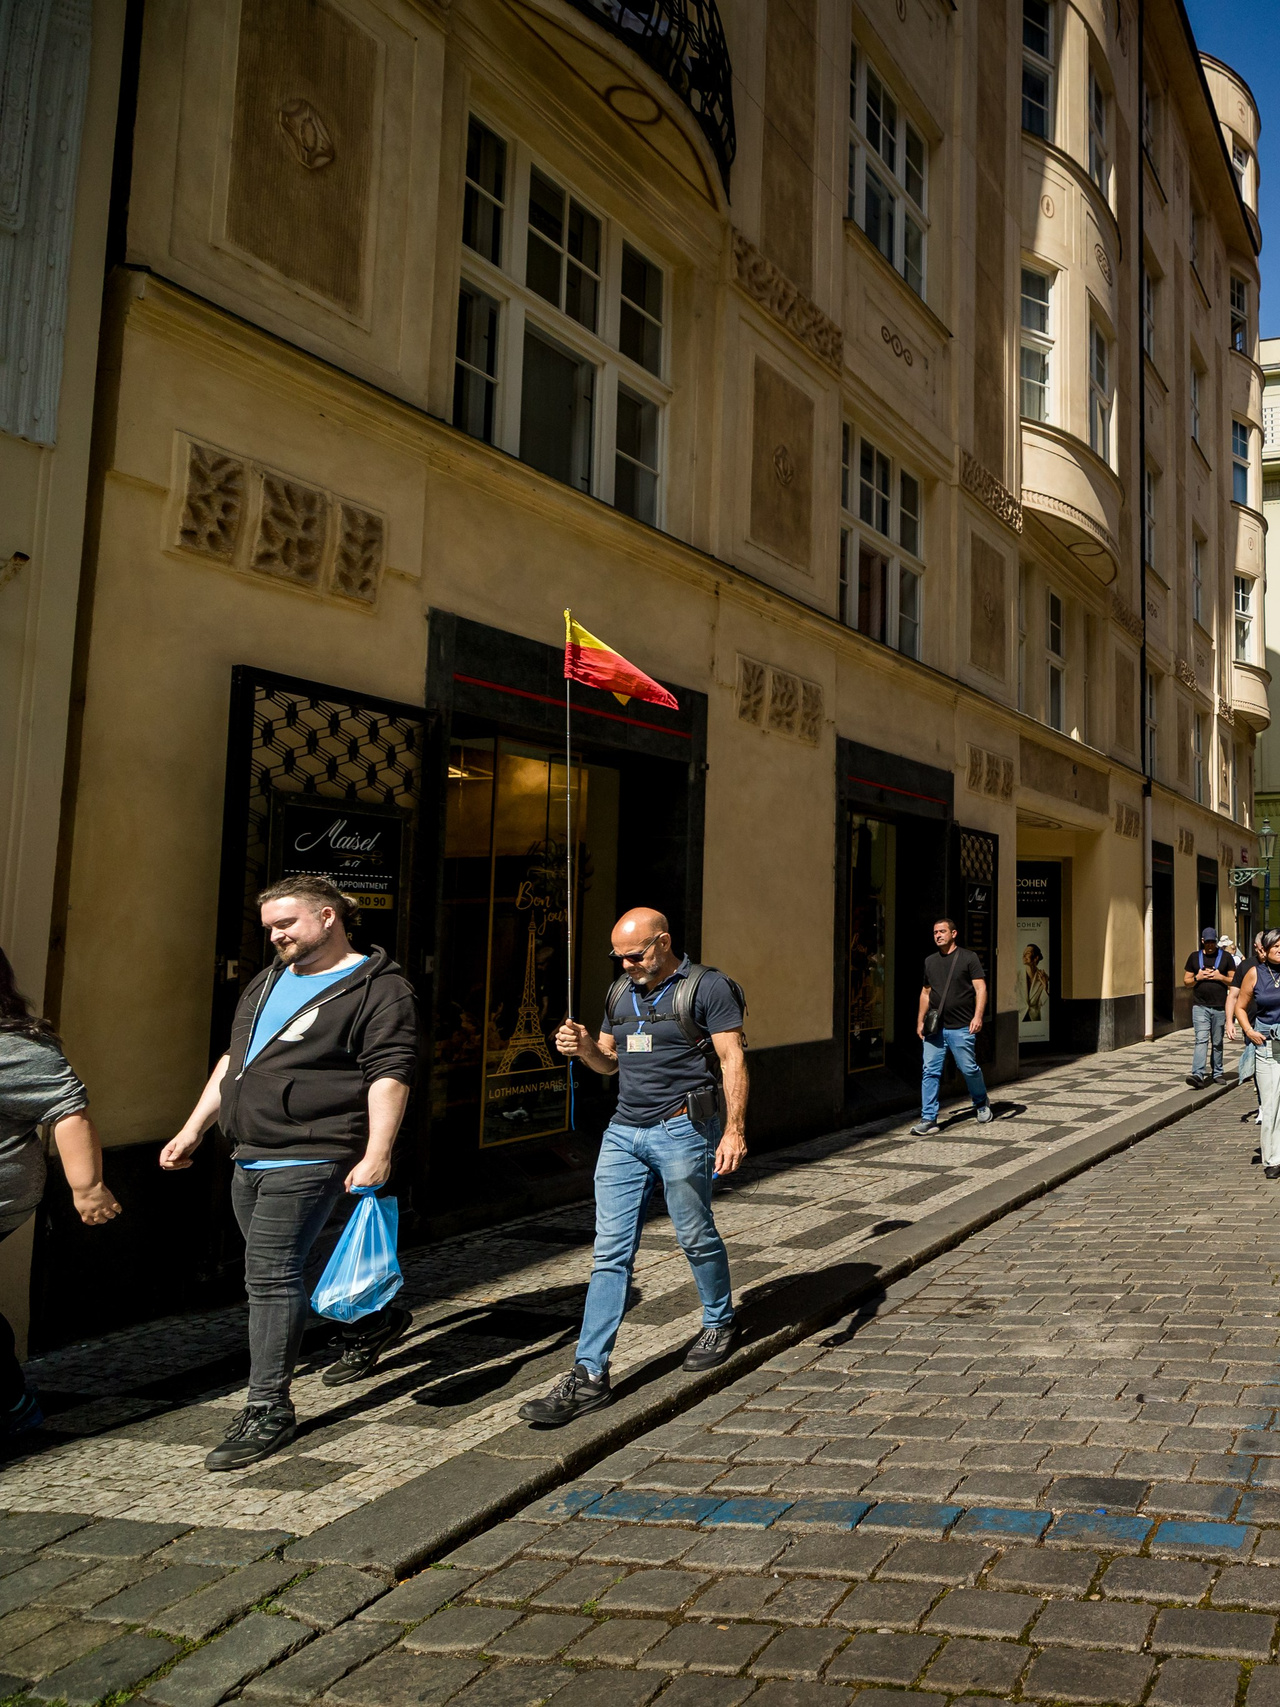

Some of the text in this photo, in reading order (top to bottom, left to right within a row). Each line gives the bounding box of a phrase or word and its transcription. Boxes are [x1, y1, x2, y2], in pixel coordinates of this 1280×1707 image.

[294, 819, 381, 852] Maisel
[338, 880, 388, 890] APPOINTMENT
[1016, 878, 1047, 888] COHEN
[373, 897, 386, 907] 90
[515, 881, 551, 910] Bon
[488, 1079, 564, 1099] LOTHMANN PARIS
